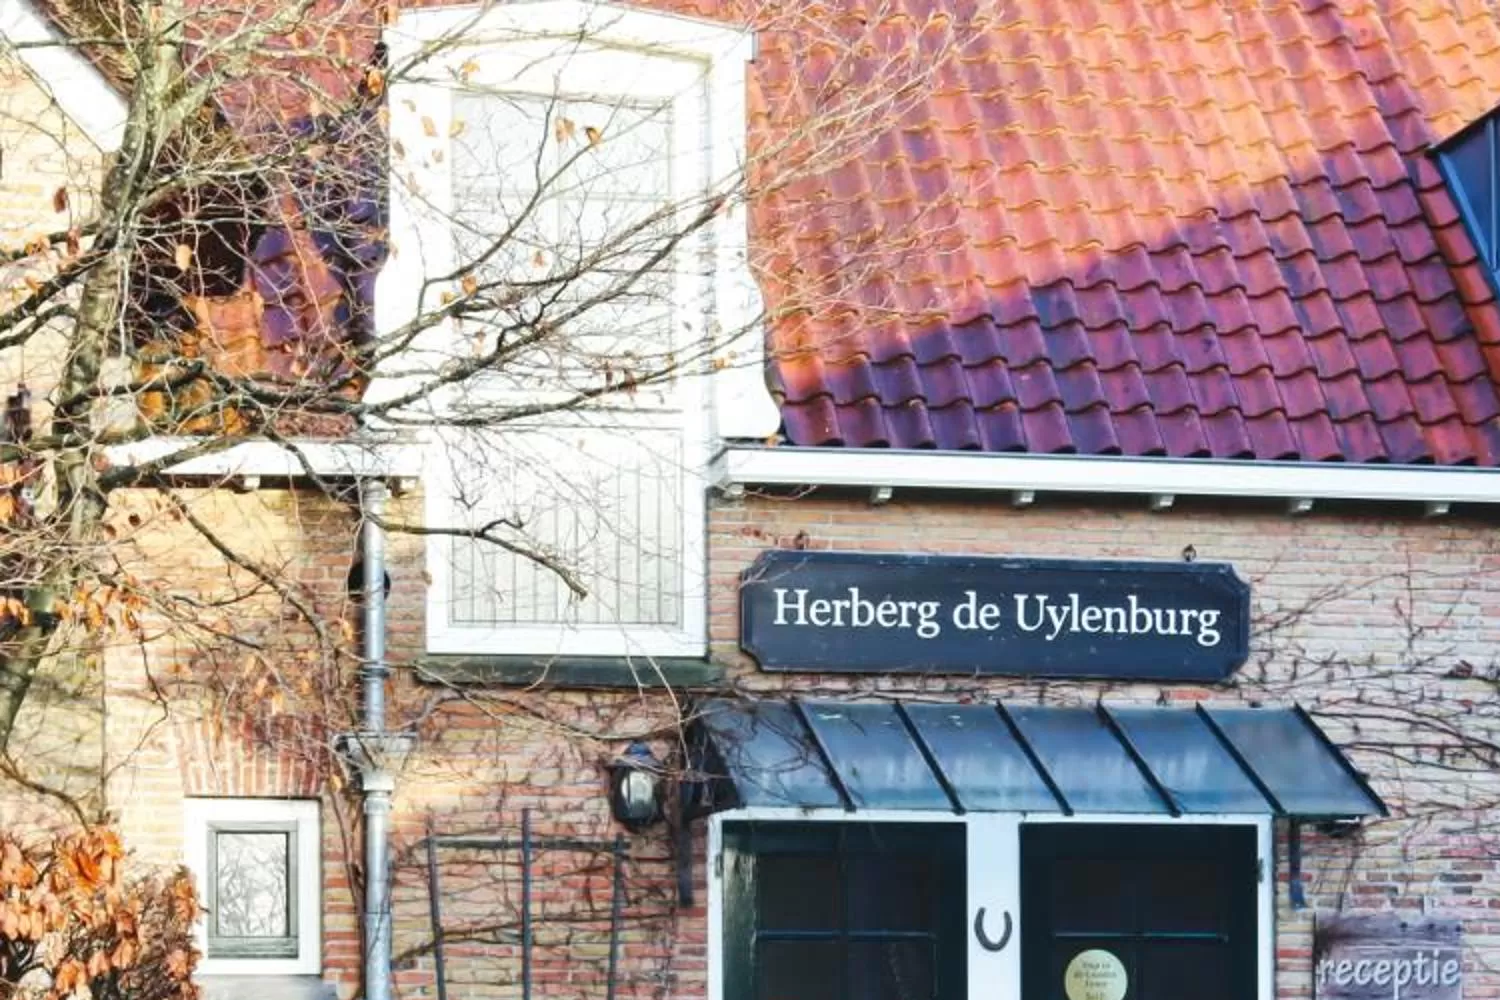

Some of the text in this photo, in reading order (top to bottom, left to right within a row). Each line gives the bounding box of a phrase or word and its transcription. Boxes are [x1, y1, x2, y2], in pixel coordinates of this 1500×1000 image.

[773, 587, 1221, 646] Herberg de Uylenburg
[1318, 950, 1460, 1000] receptie
